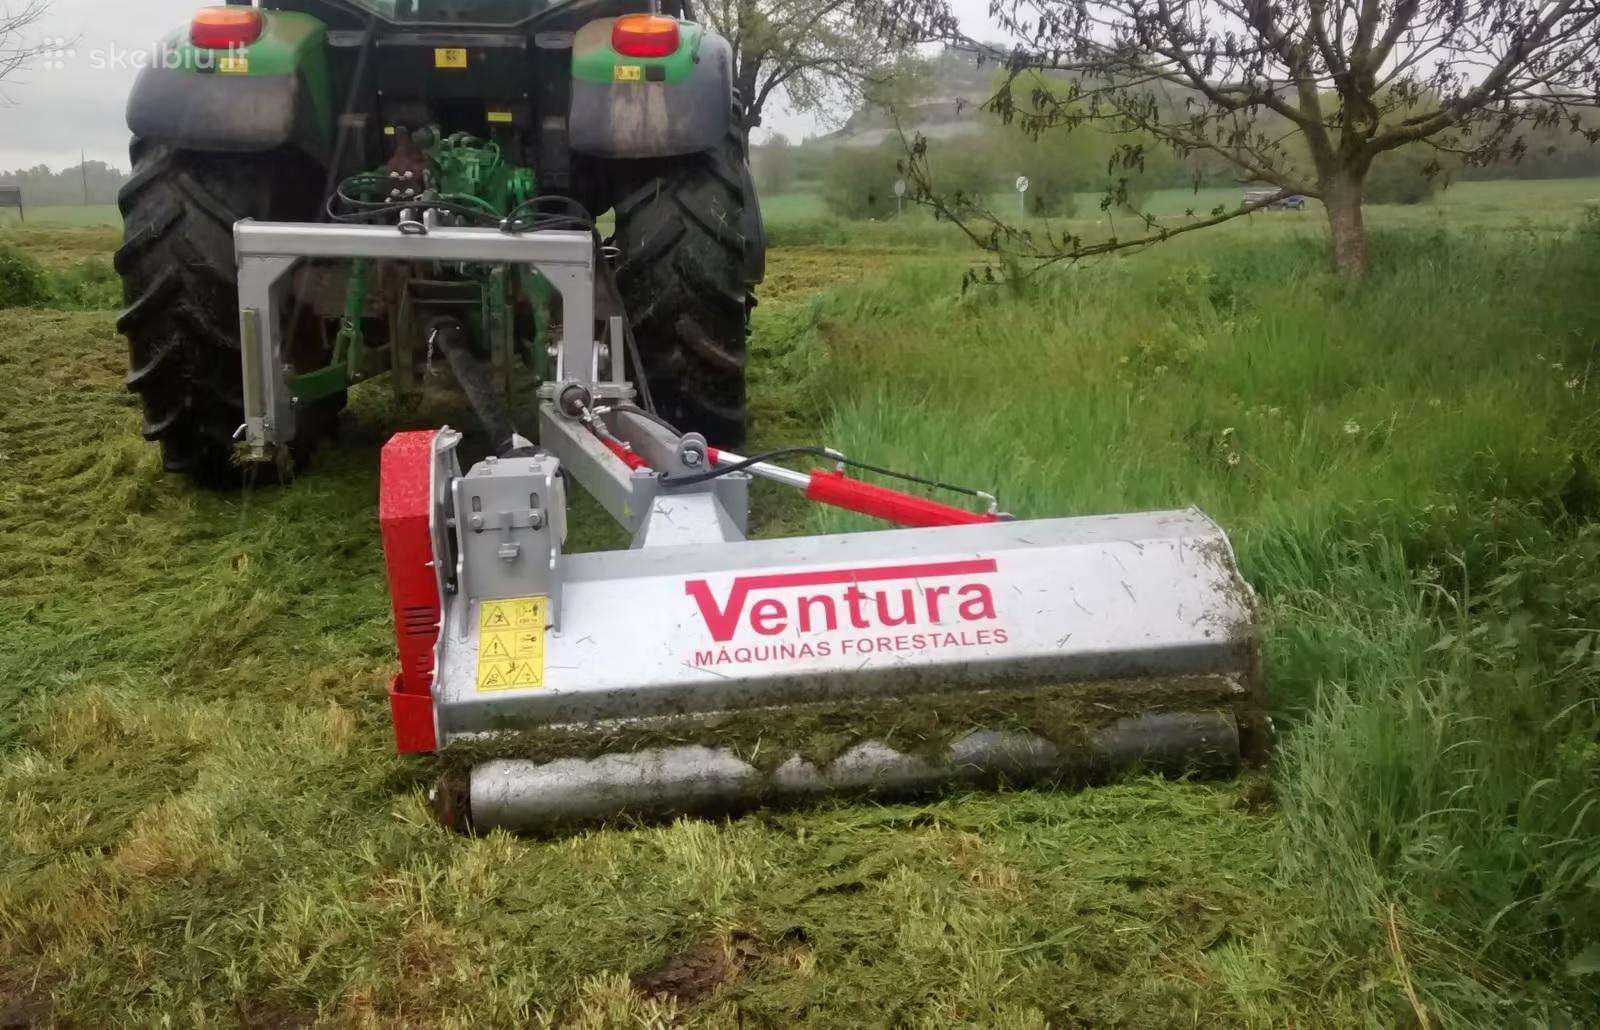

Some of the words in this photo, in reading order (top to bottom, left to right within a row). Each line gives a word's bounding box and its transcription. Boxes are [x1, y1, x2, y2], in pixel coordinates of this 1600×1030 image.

[685, 558, 997, 642] Ventura
[695, 641, 832, 667] MÁQUINAS
[841, 628, 1008, 655] FORESTALES
